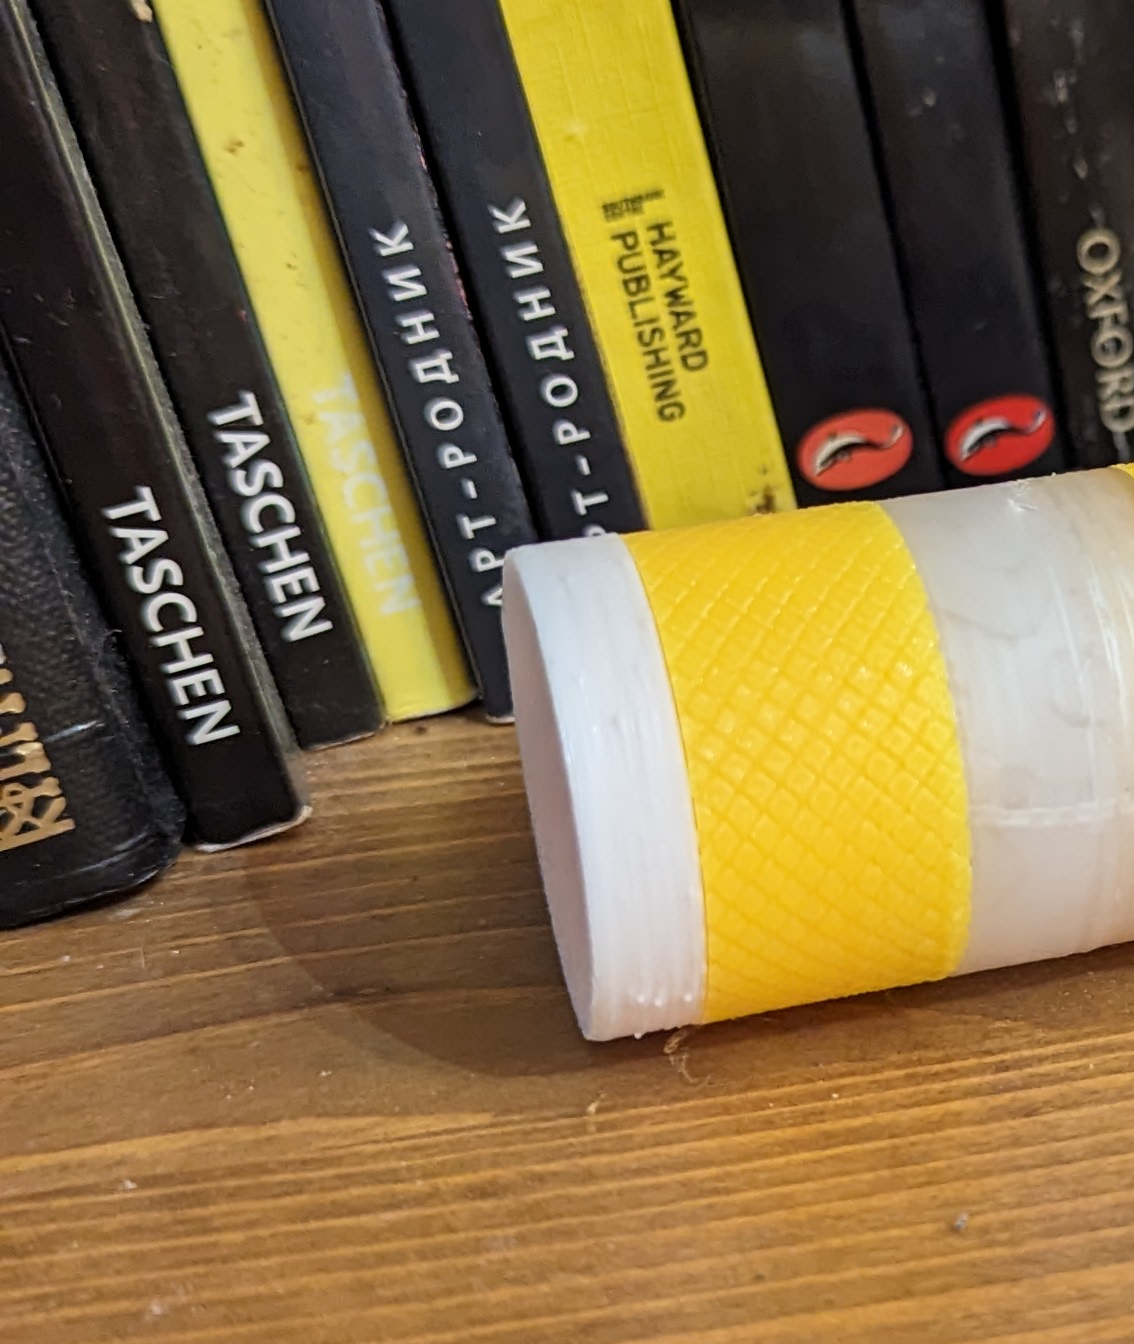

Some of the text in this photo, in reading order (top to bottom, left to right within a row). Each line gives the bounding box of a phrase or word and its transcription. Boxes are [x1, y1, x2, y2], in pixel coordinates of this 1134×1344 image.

[611, 231, 686, 423] PUBLISHING
[647, 218, 709, 373] HAYWARD
[208, 390, 334, 643] TASCHEN
[309, 370, 424, 615] TASCHEN
[101, 485, 241, 747] TASCHEN
